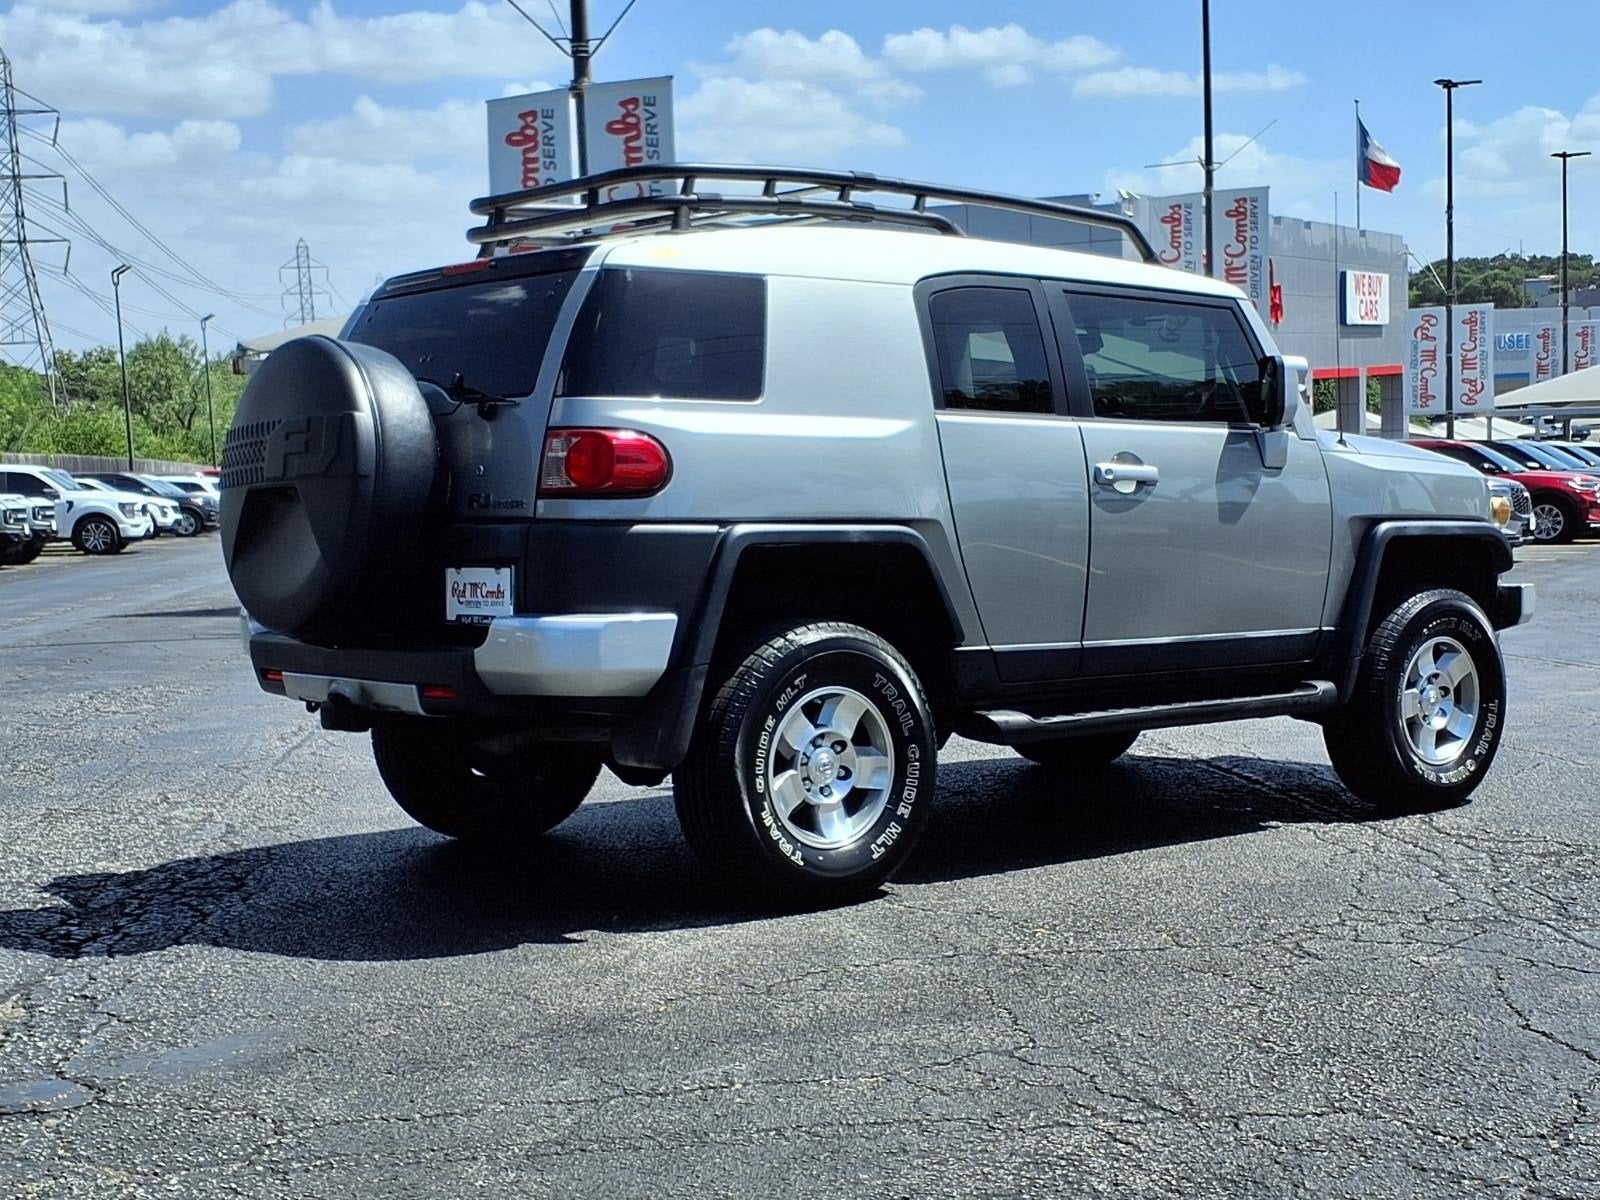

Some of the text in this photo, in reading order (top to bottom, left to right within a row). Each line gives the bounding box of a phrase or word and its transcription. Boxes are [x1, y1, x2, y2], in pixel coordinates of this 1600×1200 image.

[541, 107, 557, 170] SERVE
[642, 95, 660, 161] SERVE
[1183, 203, 1193, 238] SERVE
[1184, 241, 1193, 256] TO
[1223, 197, 1248, 284] McCombs
[1249, 196, 1260, 299] DRIVEN TO SERVE
[1353, 273, 1383, 298] WE BUY
[1358, 299, 1379, 321] CARS
[1413, 314, 1438, 409] Red McCombs
[1459, 310, 1485, 406] Red McCombs
[1536, 327, 1550, 379] McCombs
[451, 581, 505, 605] Red McCombs
[1474, 699, 1498, 756] TRAIL
[755, 673, 808, 866] TRAIL GUIDE HLT
[870, 672, 921, 860] TRAIL GUIDE HLT
